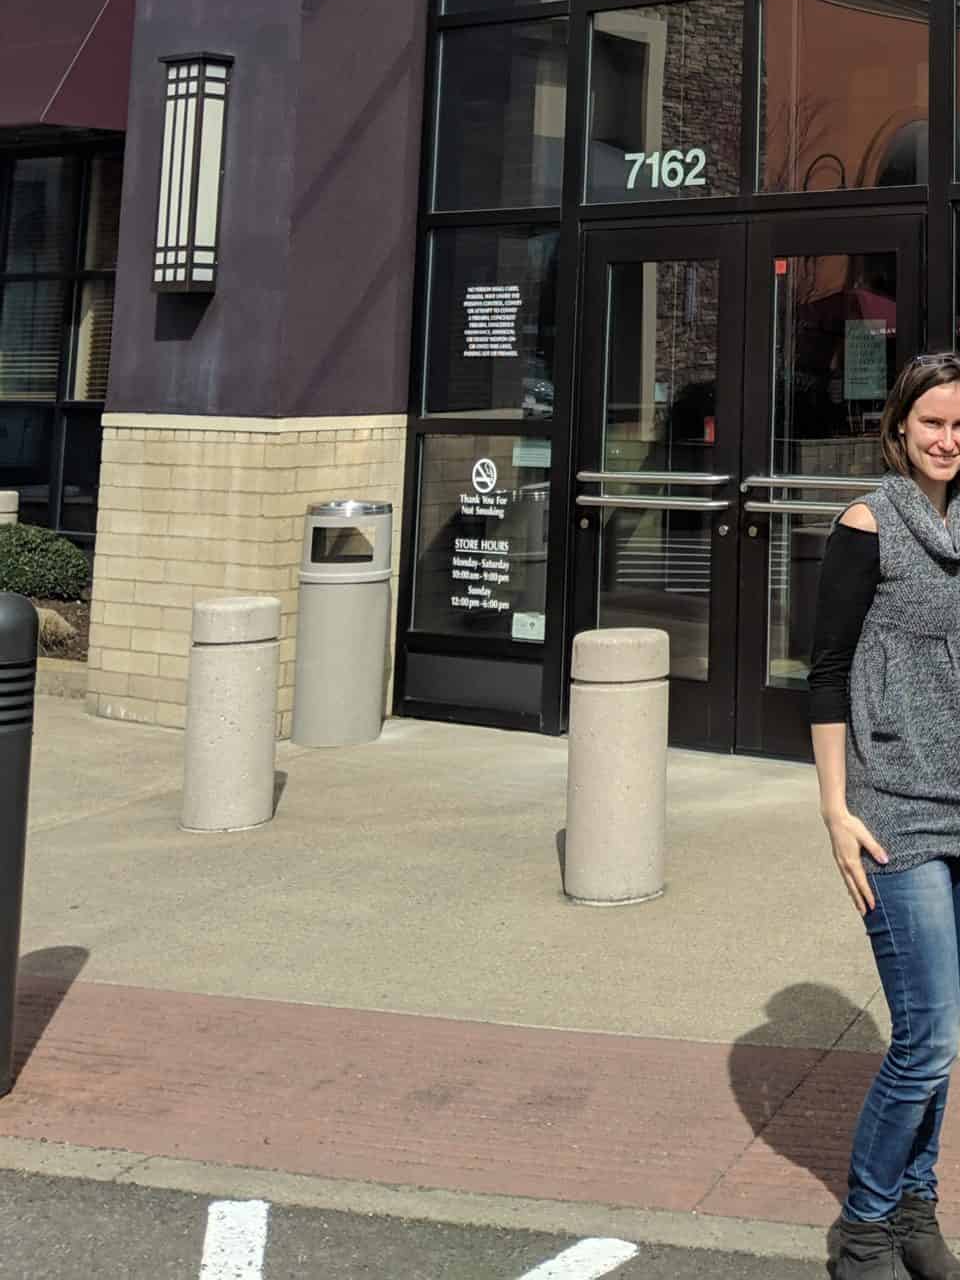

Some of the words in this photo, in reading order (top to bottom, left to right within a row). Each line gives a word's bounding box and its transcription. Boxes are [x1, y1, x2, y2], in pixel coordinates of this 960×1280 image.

[624, 148, 706, 189] 7162
[455, 538, 479, 550] STORE
[481, 540, 509, 551] HOURS
